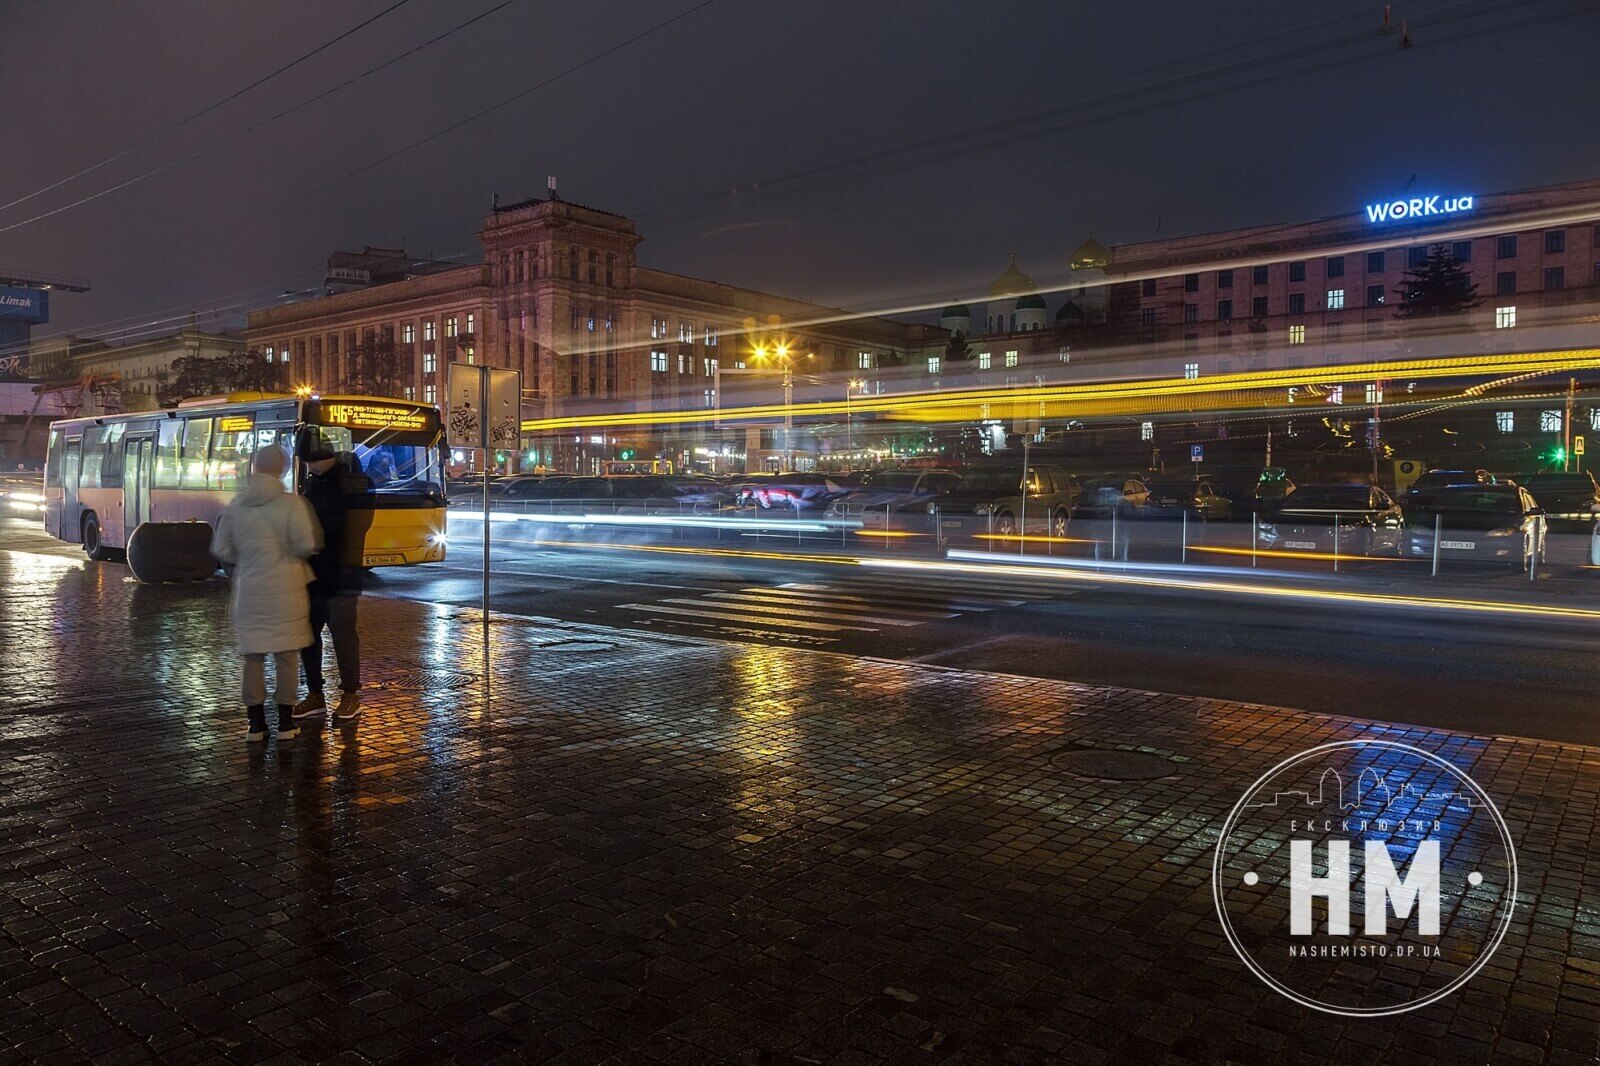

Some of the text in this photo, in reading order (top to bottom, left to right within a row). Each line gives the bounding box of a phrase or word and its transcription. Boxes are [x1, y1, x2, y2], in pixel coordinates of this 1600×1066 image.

[1366, 195, 1473, 222] WORK.ua
[0, 295, 31, 306] Limak
[1194, 446, 1201, 455] P
